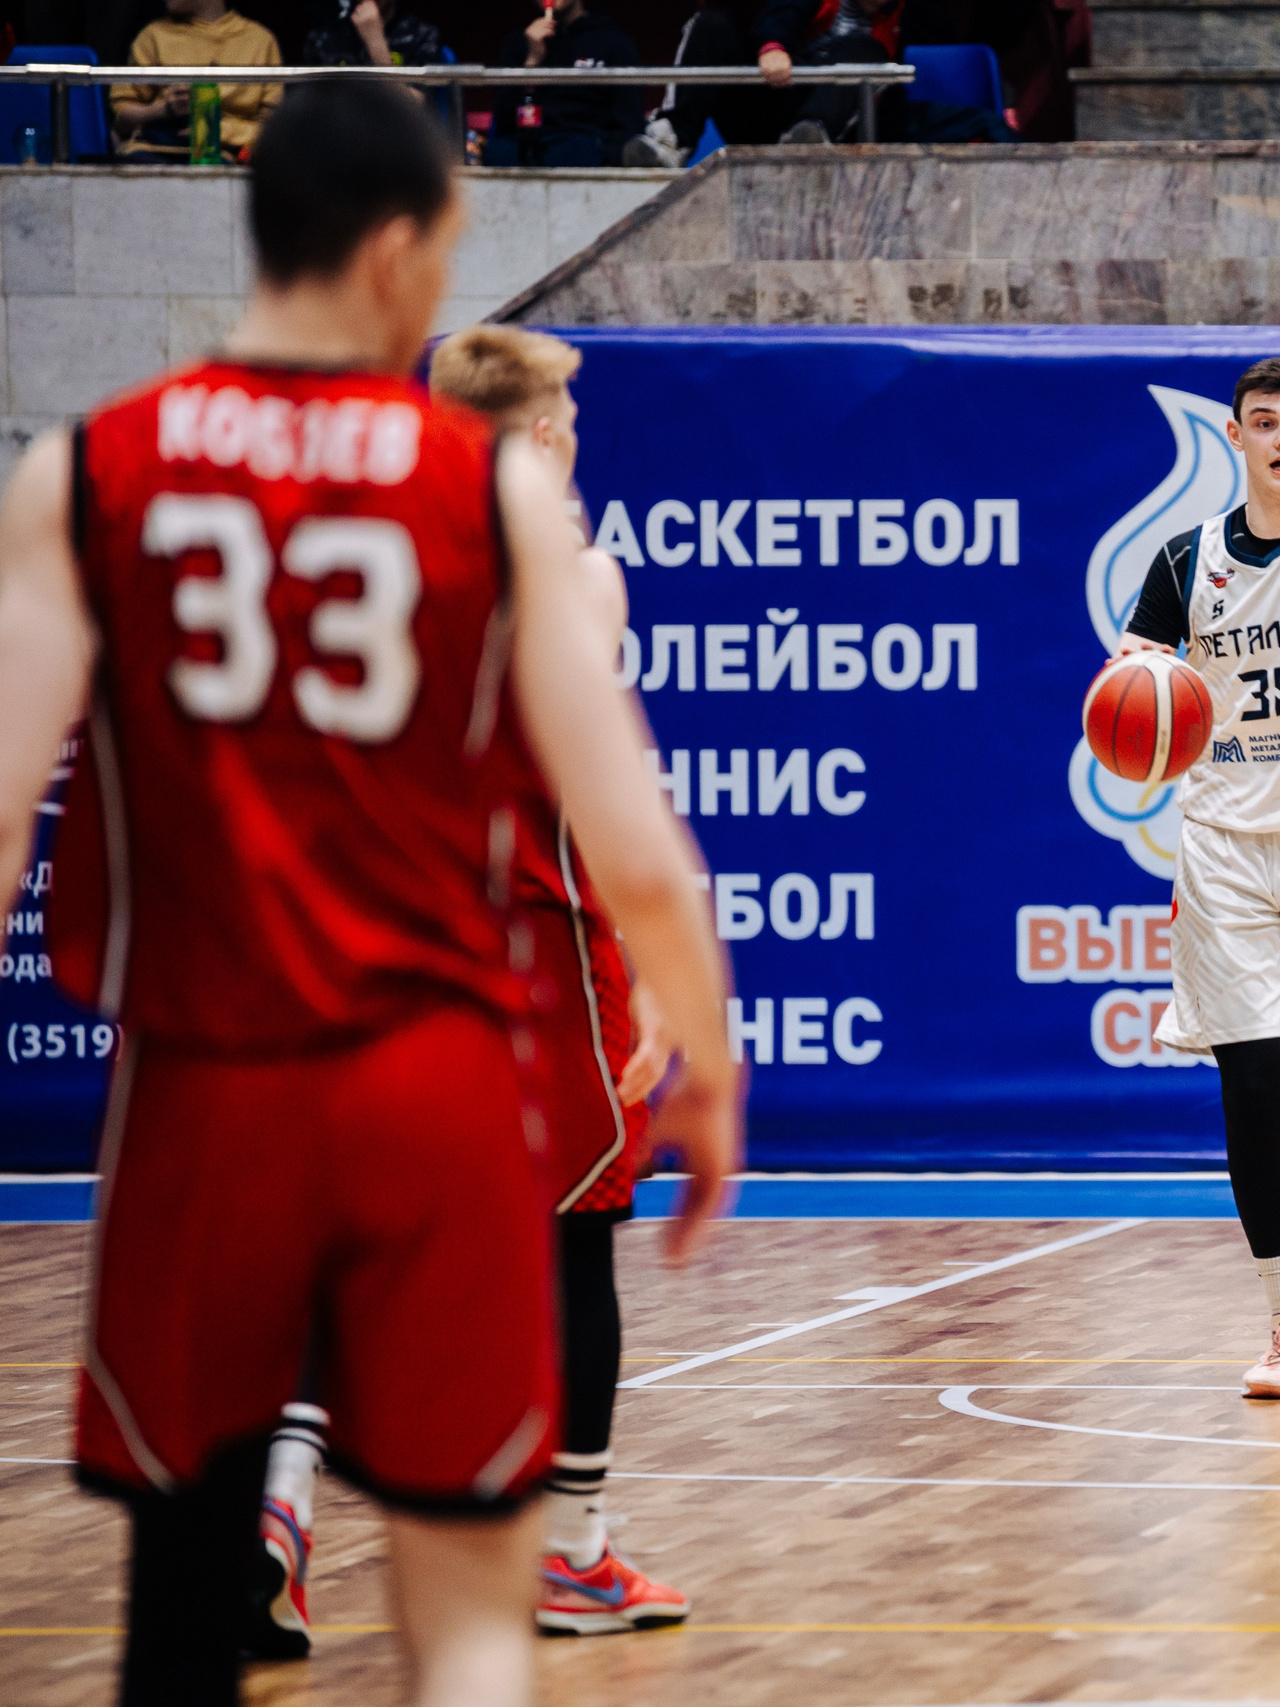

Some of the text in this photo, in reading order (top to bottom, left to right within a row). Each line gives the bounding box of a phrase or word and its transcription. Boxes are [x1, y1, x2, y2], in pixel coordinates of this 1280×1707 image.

[143, 493, 420, 744] 33
[615, 608, 978, 691] ОЛЕЙБОЛ
[646, 748, 866, 815] ННИС
[692, 872, 875, 940] БОЛ
[8, 1023, 124, 1063] (3519)
[727, 997, 883, 1064] НЕС
